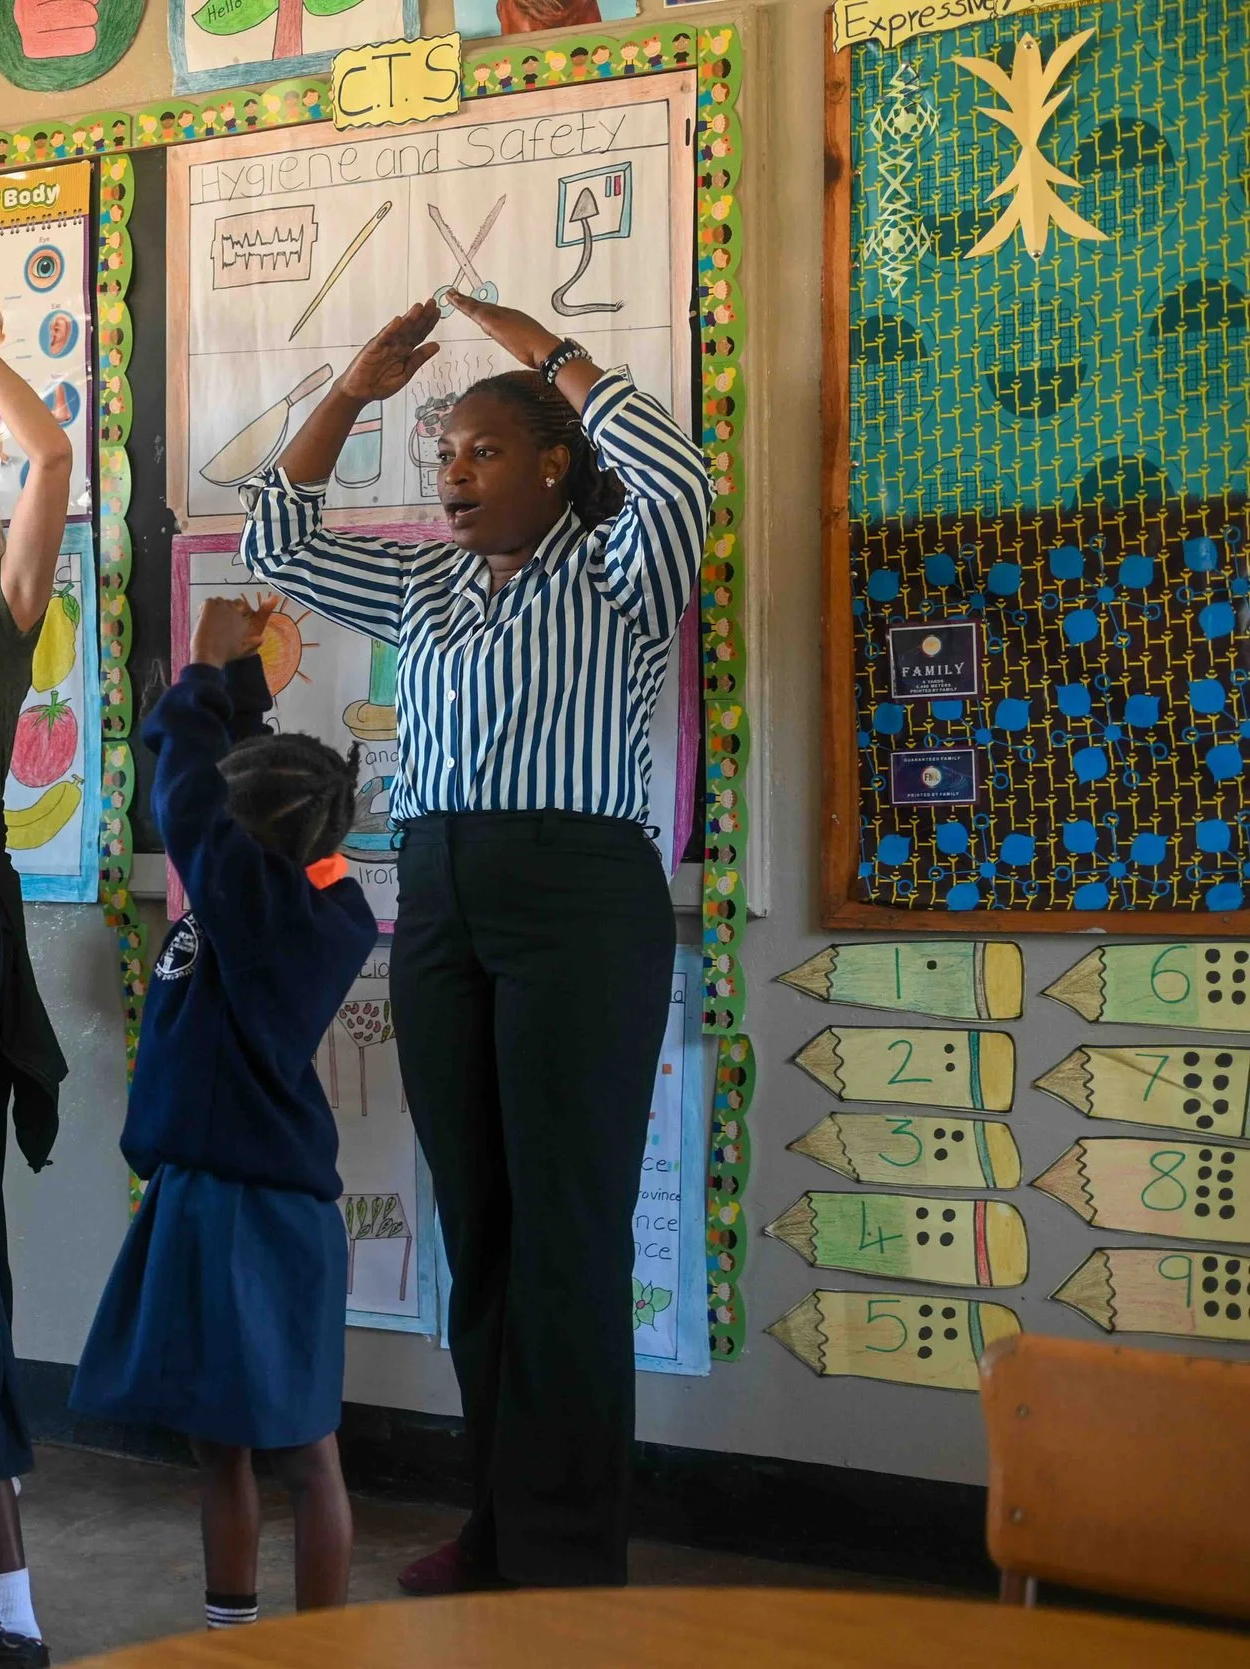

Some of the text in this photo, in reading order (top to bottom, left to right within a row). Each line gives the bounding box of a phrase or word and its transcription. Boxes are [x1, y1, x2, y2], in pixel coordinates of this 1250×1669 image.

[208, 0, 242, 24] Hello
[200, 113, 627, 201] Hygiene and Safety
[4, 184, 60, 206] Body
[902, 662, 965, 677] FAMILY
[1151, 945, 1191, 1003] 6
[888, 1040, 933, 1085] 2
[1135, 1053, 1170, 1102] 7
[878, 1118, 923, 1167] 3
[639, 1187, 681, 1202] rovince
[1141, 1151, 1187, 1211] 8
[859, 1200, 903, 1254] 4
[1158, 1255, 1192, 1308] 9
[865, 1300, 907, 1352] 5
